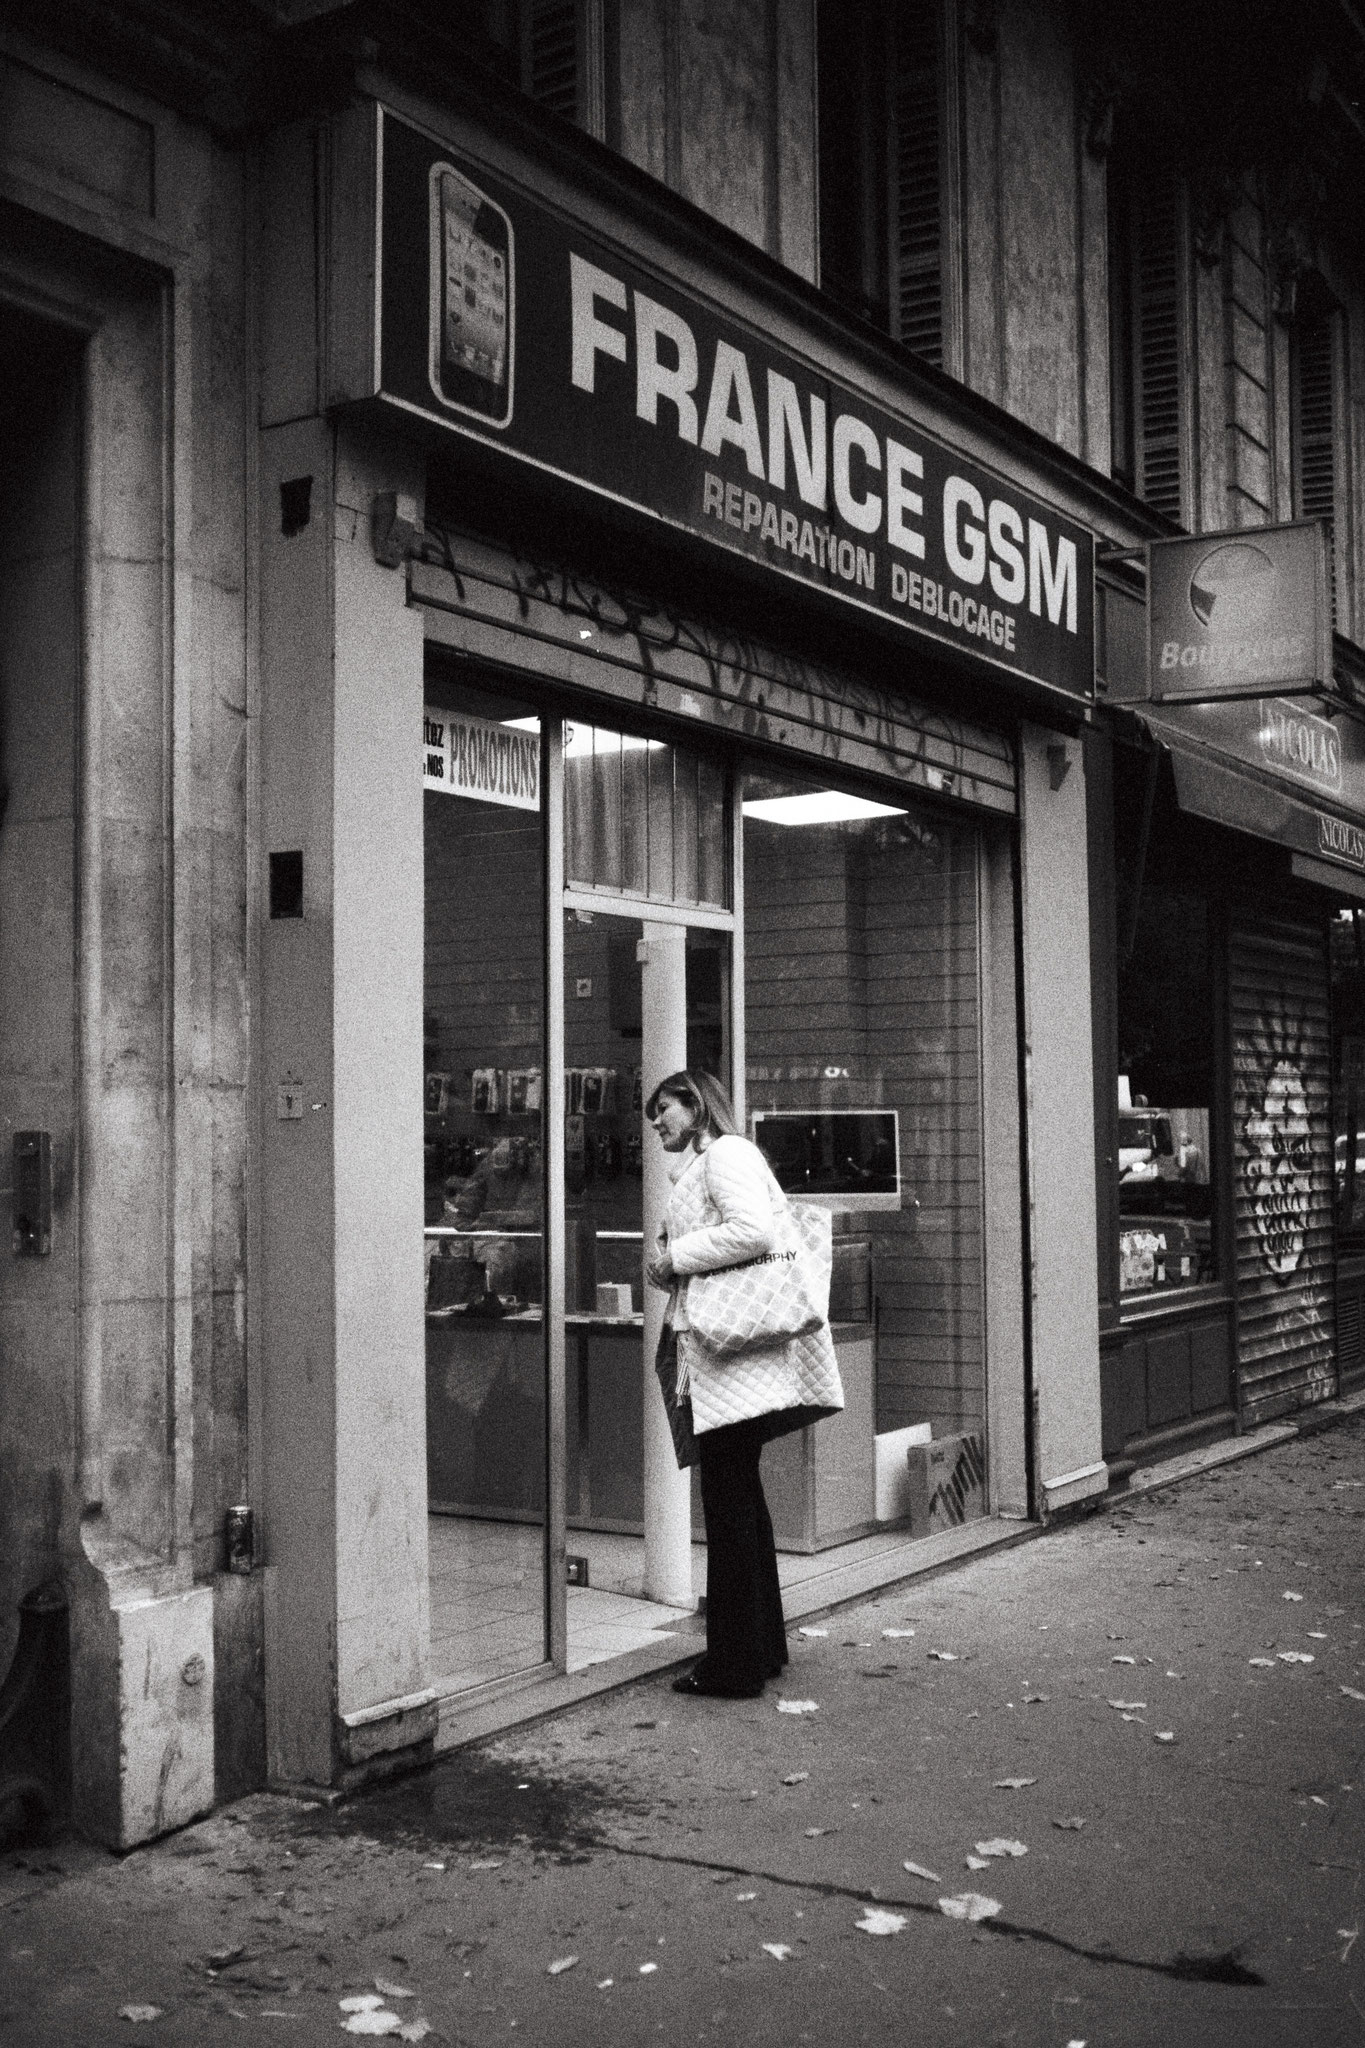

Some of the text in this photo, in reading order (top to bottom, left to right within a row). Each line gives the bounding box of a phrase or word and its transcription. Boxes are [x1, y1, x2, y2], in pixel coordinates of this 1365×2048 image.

[570, 251, 1078, 634] FRANCE GSM
[702, 470, 1016, 653] REPARATION DEBLOCAGE
[427, 753, 444, 778] NOS
[449, 722, 537, 799] PROMOTIONS
[1266, 708, 1337, 777] NICOLAS
[1321, 817, 1364, 859] NICOLAS
